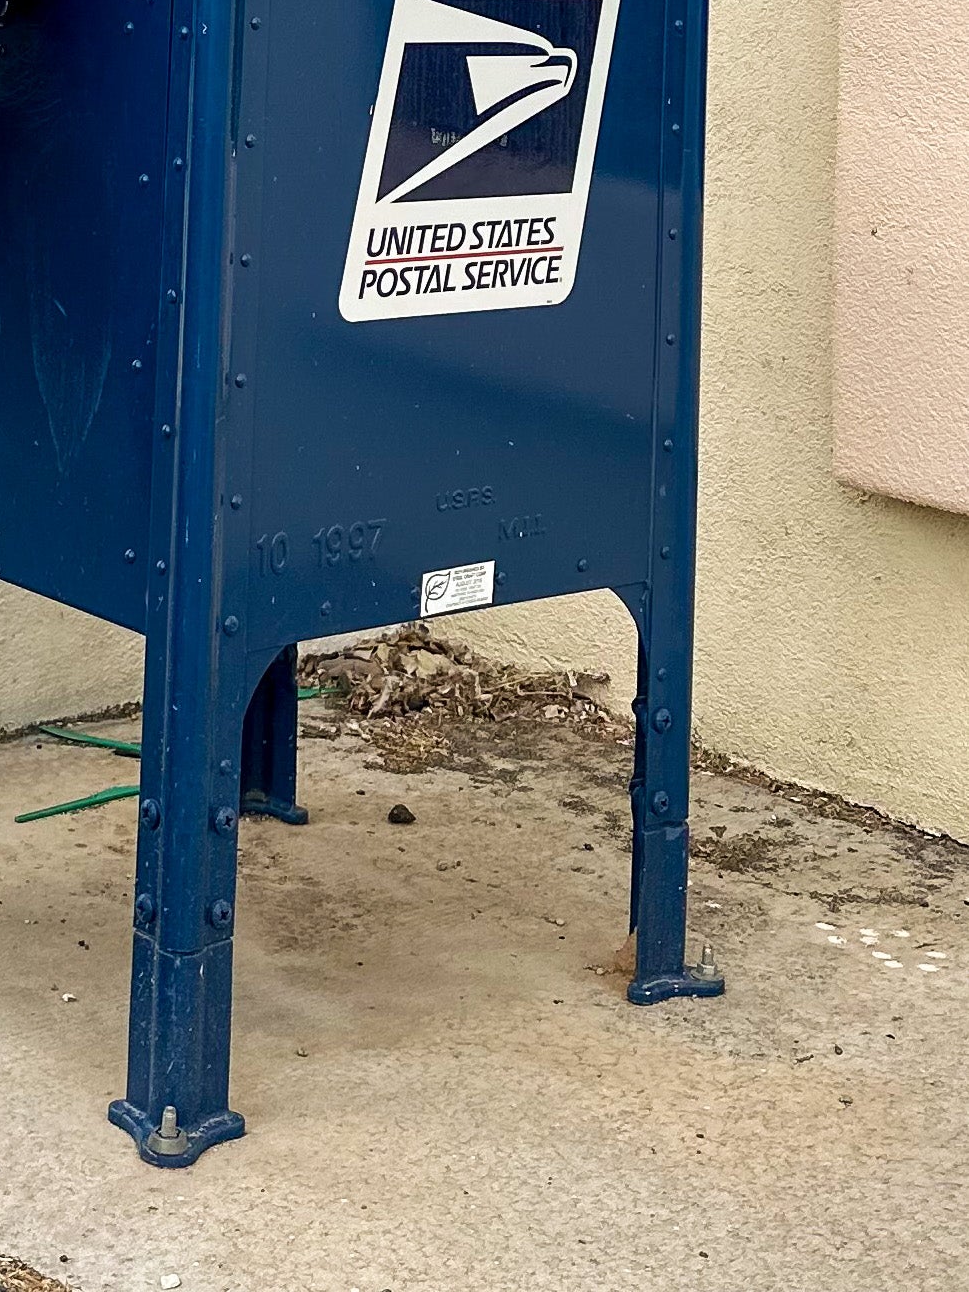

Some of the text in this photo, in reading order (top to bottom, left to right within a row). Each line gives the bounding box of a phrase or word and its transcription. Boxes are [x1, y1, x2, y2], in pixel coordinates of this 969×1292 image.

[366, 216, 557, 258] UNITED STATES
[358, 254, 563, 300] POSTAL SERVICE
[254, 516, 388, 578] 10 1997
